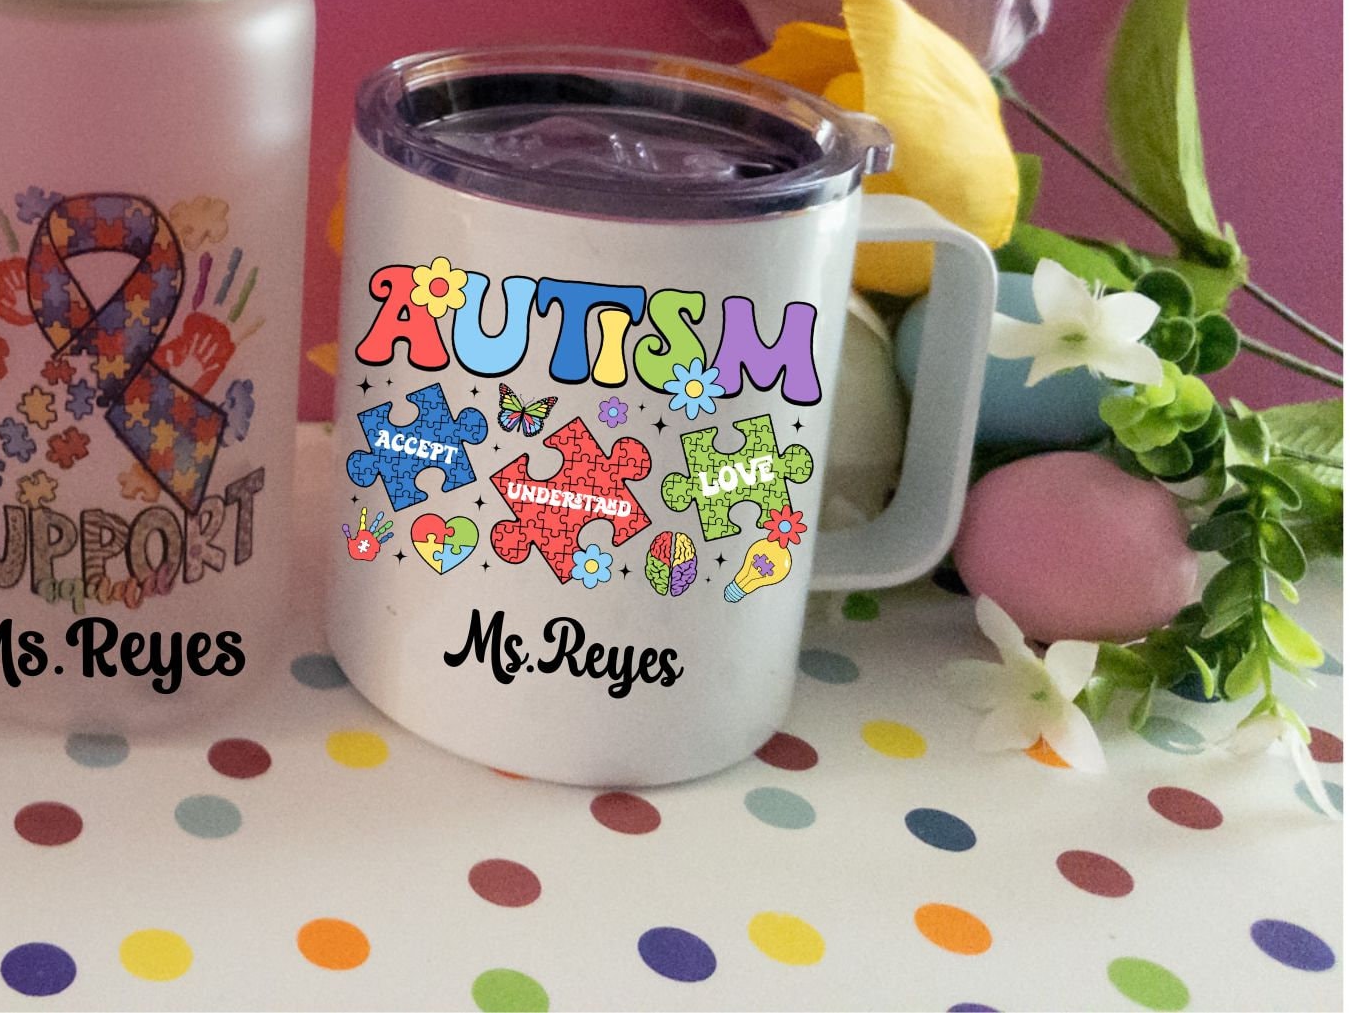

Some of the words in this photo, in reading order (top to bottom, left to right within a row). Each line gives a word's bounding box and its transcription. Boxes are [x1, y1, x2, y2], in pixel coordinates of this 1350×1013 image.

[354, 263, 824, 406] AUTISM
[374, 429, 459, 465] ACCEPT
[697, 453, 776, 497] LOVE
[506, 481, 632, 518] UNDERSTAND
[65, 616, 246, 695] Reyes
